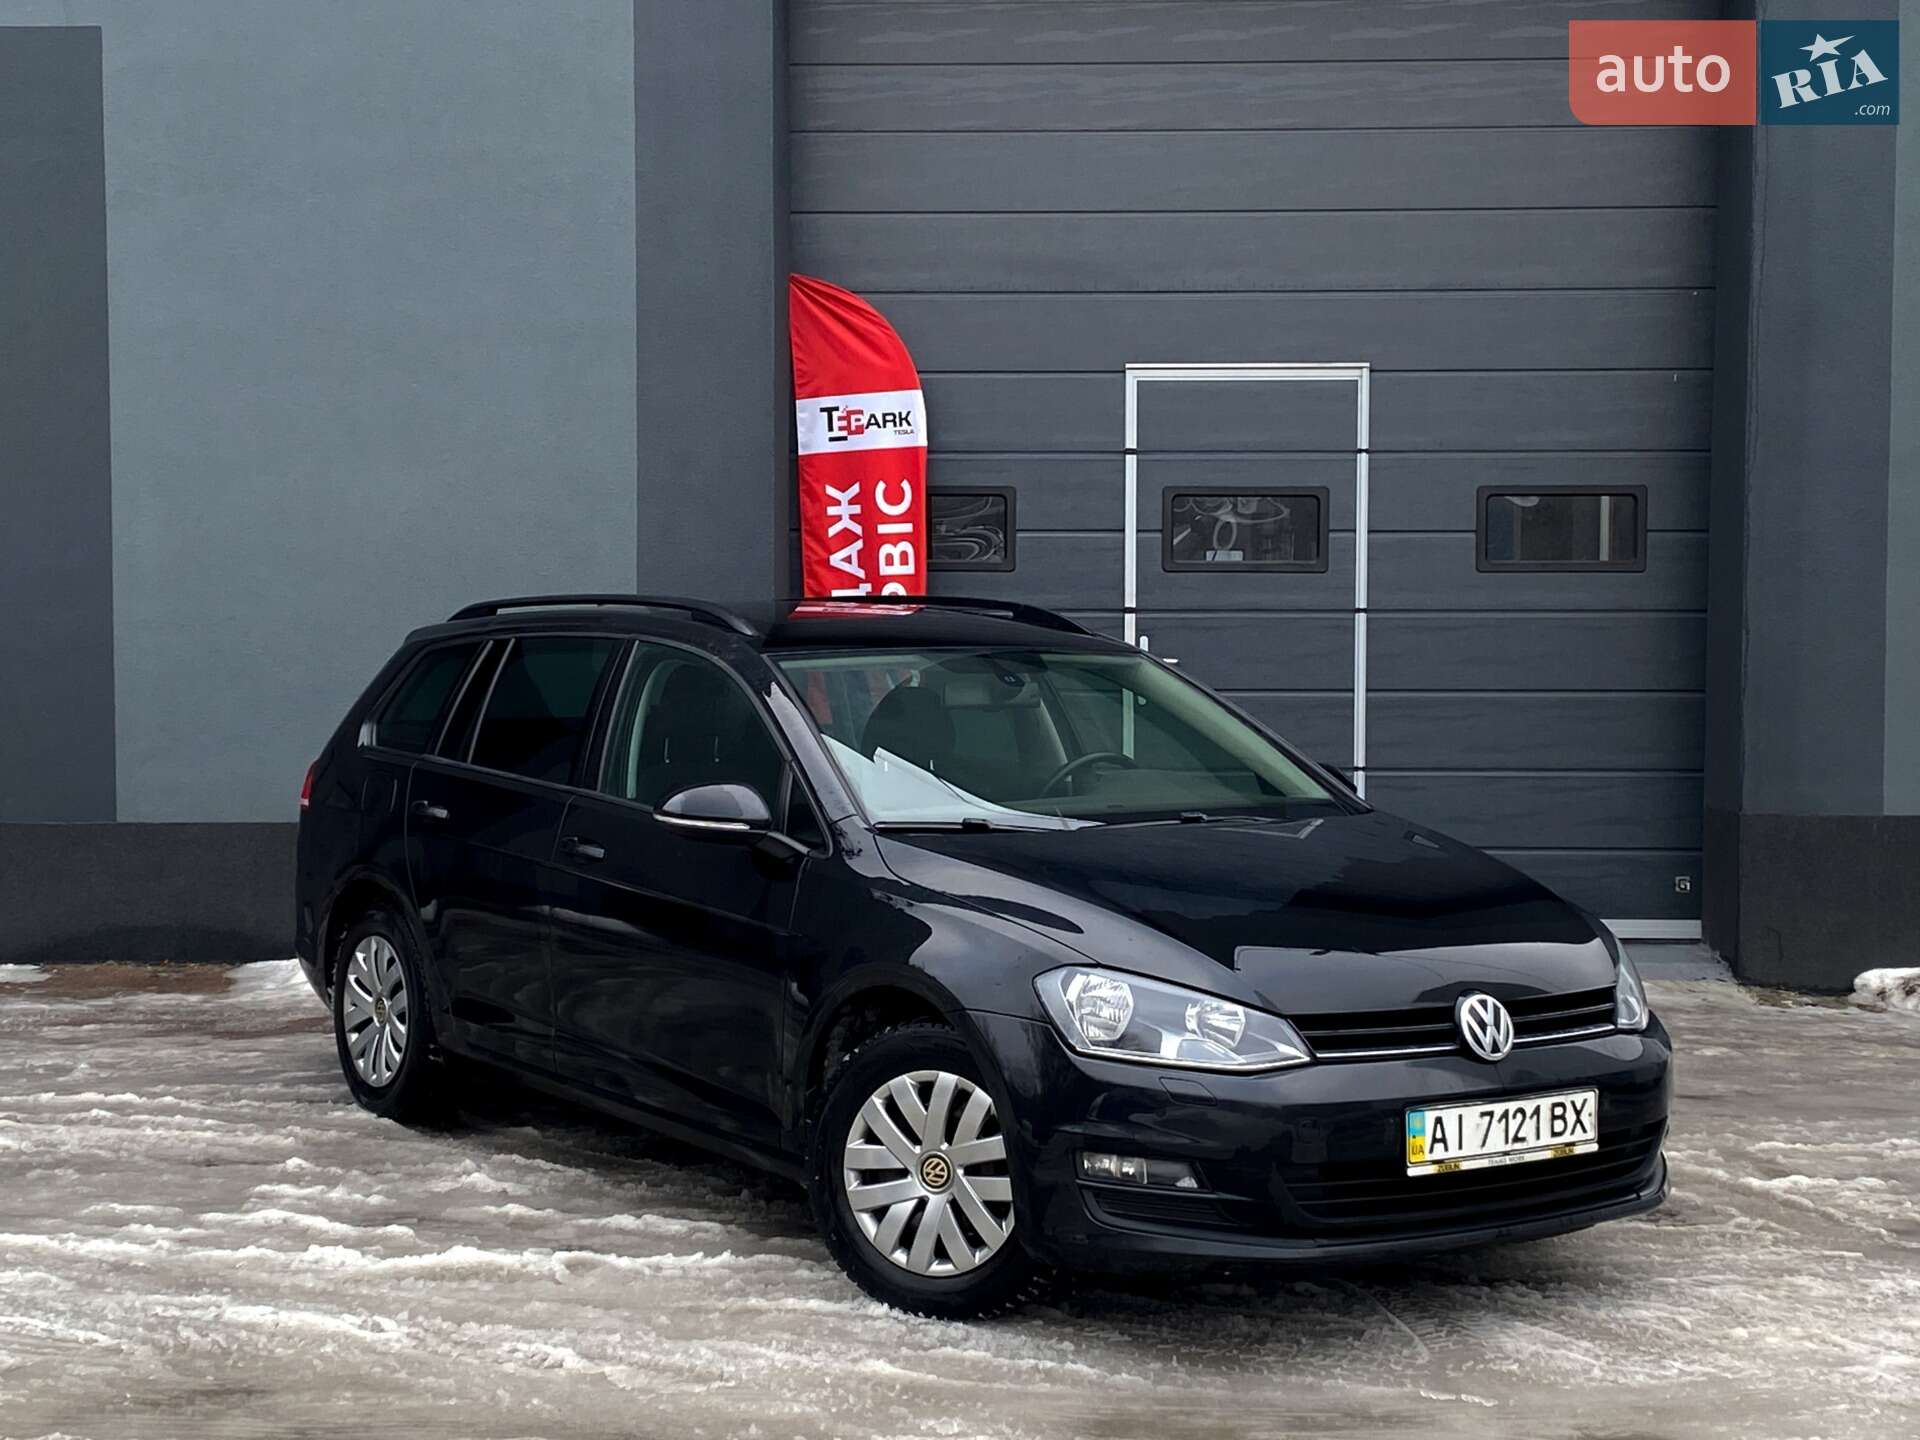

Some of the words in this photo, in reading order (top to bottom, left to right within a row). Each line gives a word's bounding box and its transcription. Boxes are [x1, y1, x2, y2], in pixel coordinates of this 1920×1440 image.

[1428, 1113, 1463, 1155] AI
[1479, 1104, 1541, 1150] 7121
[1550, 1098, 1588, 1138] BX
[1411, 1144, 1425, 1155] UA
